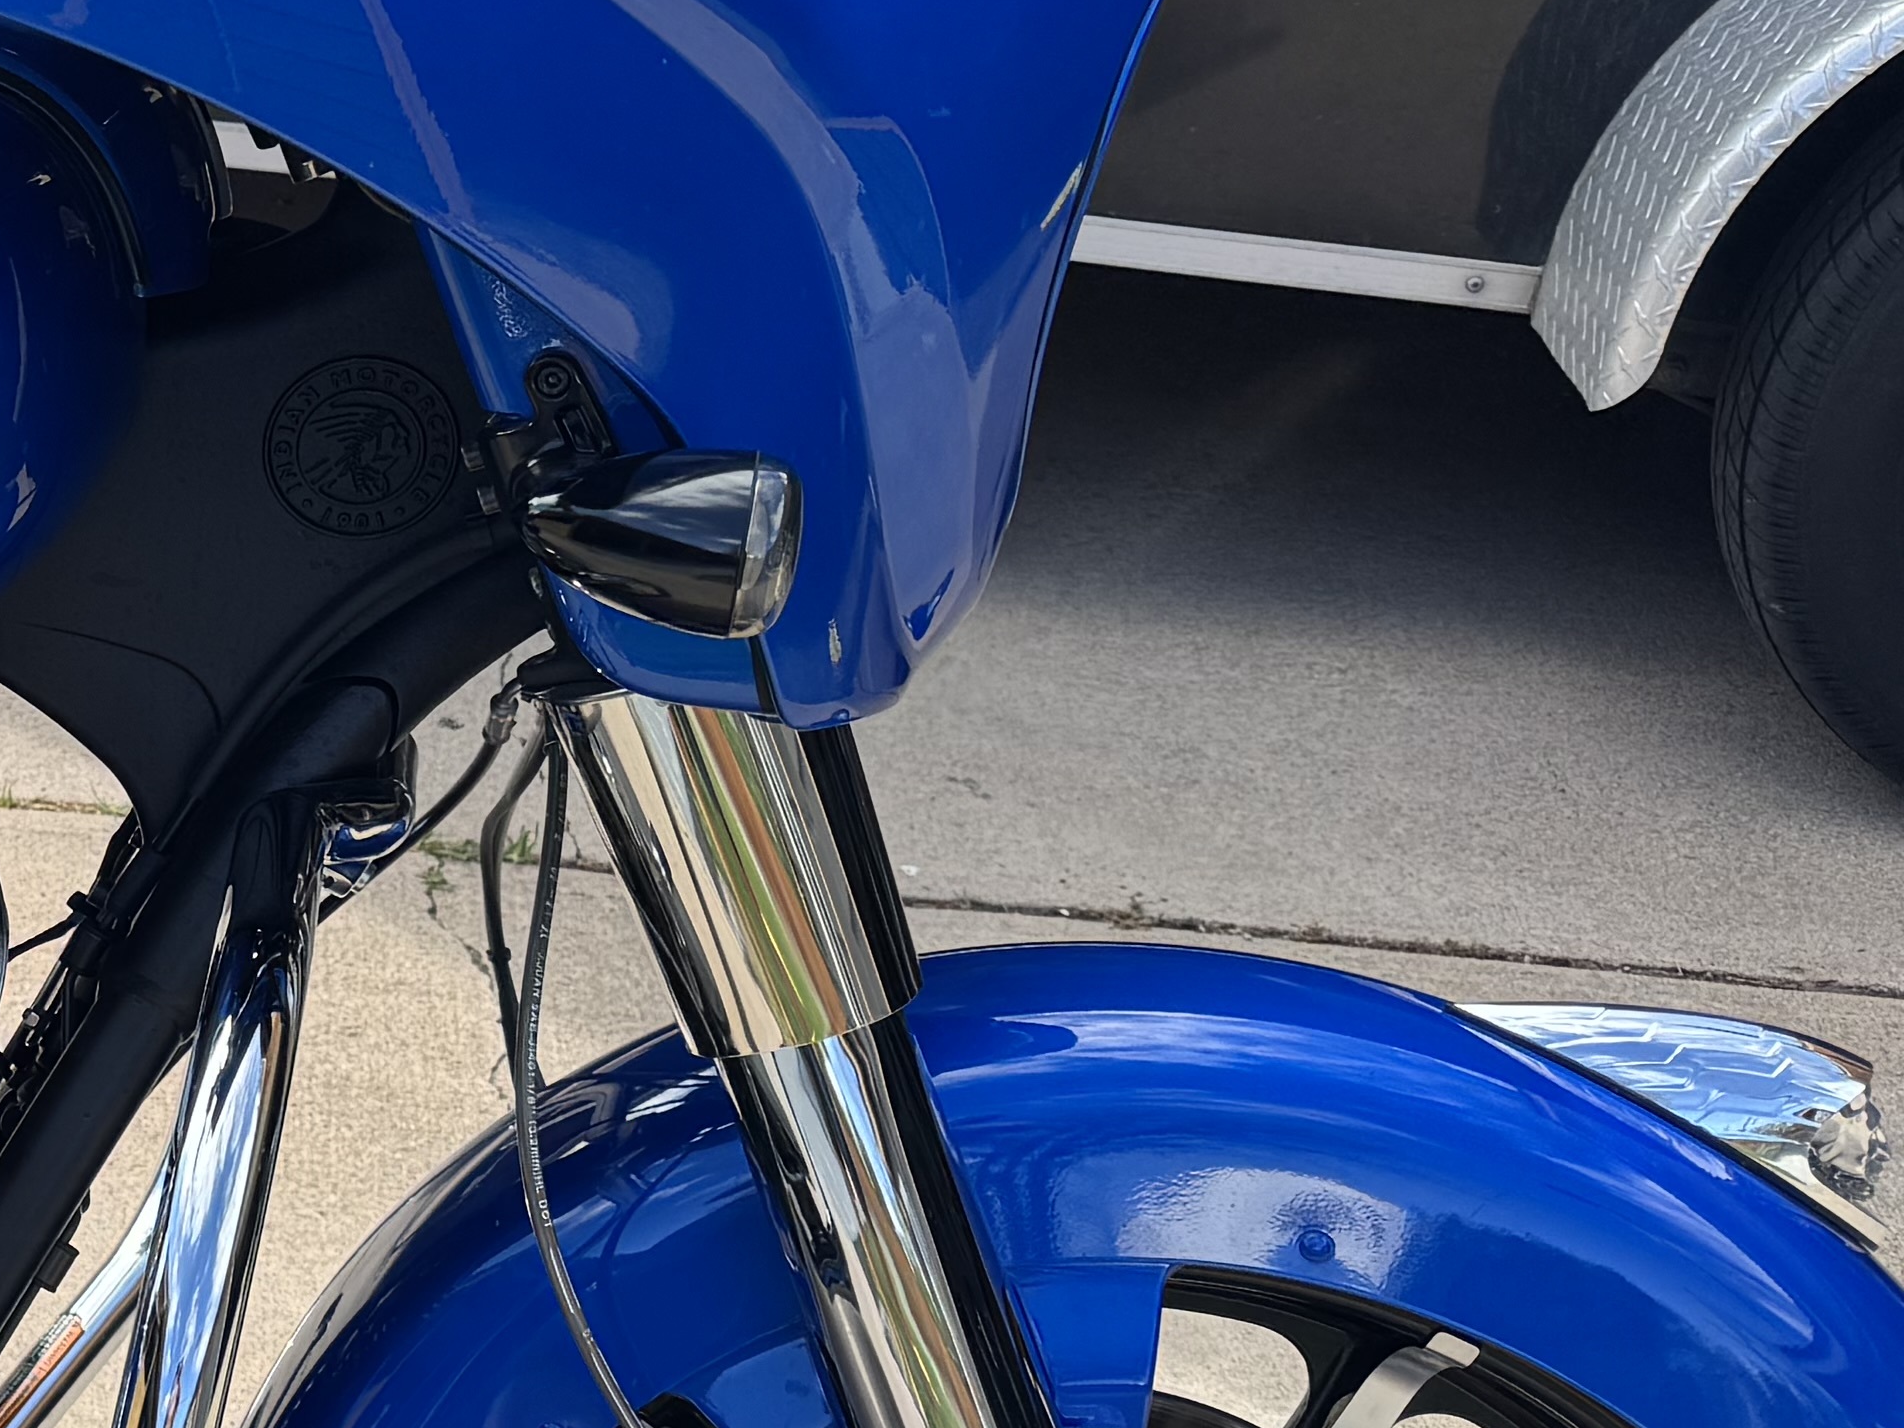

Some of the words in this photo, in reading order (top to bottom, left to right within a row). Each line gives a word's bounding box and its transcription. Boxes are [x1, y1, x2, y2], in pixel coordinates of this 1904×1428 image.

[273, 384, 322, 495] INDIAN
[319, 505, 386, 529] 1901
[538, 1199, 552, 1228] DOT
